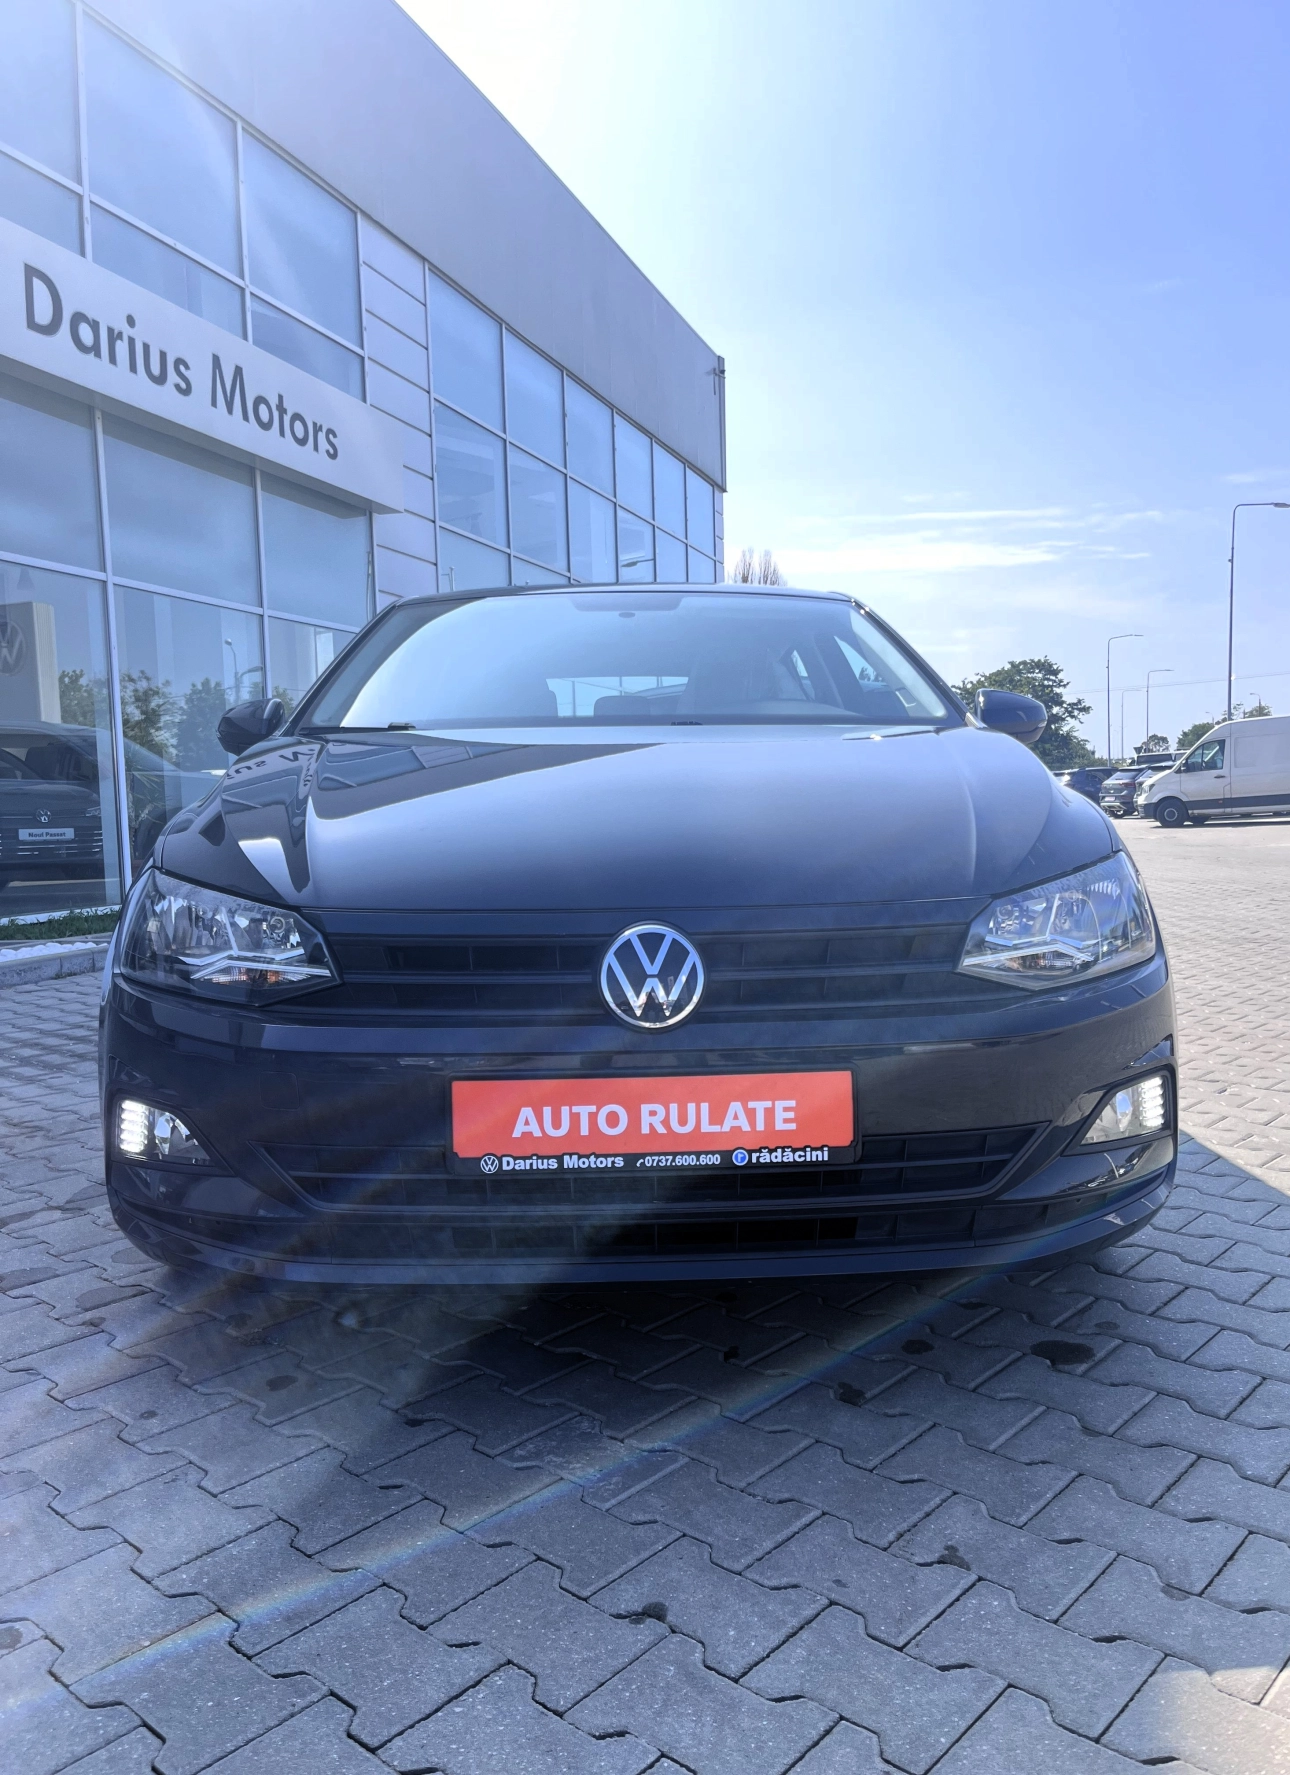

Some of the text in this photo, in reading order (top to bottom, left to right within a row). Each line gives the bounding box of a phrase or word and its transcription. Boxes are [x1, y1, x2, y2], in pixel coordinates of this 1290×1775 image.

[23, 261, 339, 461] Darius Motors
[601, 926, 702, 1028] VW
[512, 1100, 797, 1138] AUTO RULATE
[502, 1156, 558, 1171] Darius
[563, 1154, 625, 1169] Motors
[644, 1153, 721, 1167] 0737.600.600
[751, 1147, 829, 1163] rădăcini
